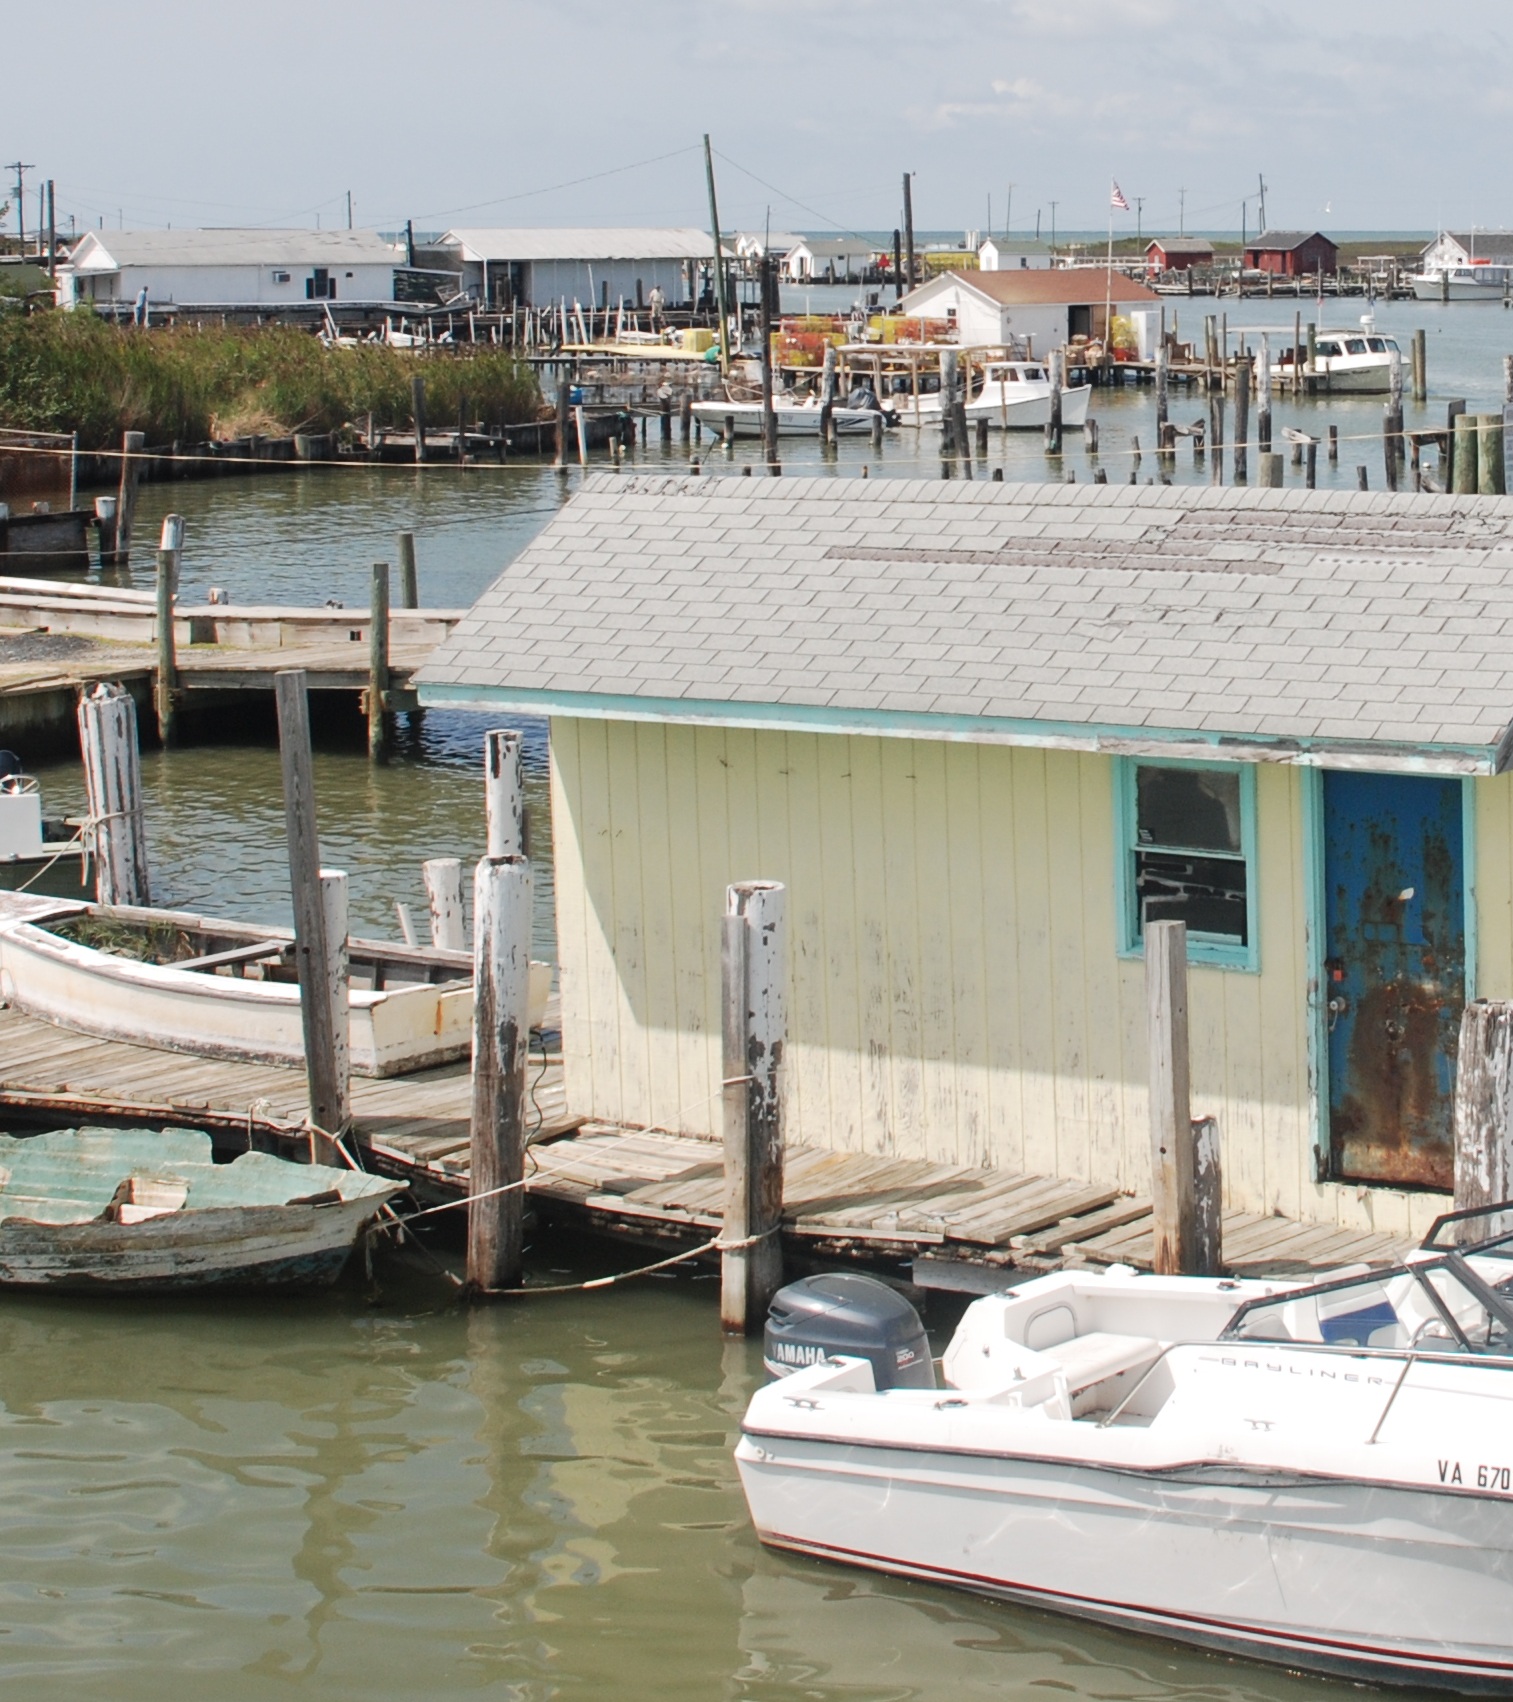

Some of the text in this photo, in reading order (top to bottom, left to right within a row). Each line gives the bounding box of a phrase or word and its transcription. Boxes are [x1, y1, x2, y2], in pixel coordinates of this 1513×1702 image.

[771, 1342, 826, 1365] YAMAHA
[1221, 1357, 1383, 1386] BAYLINER
[1438, 1459, 1463, 1485] VA
